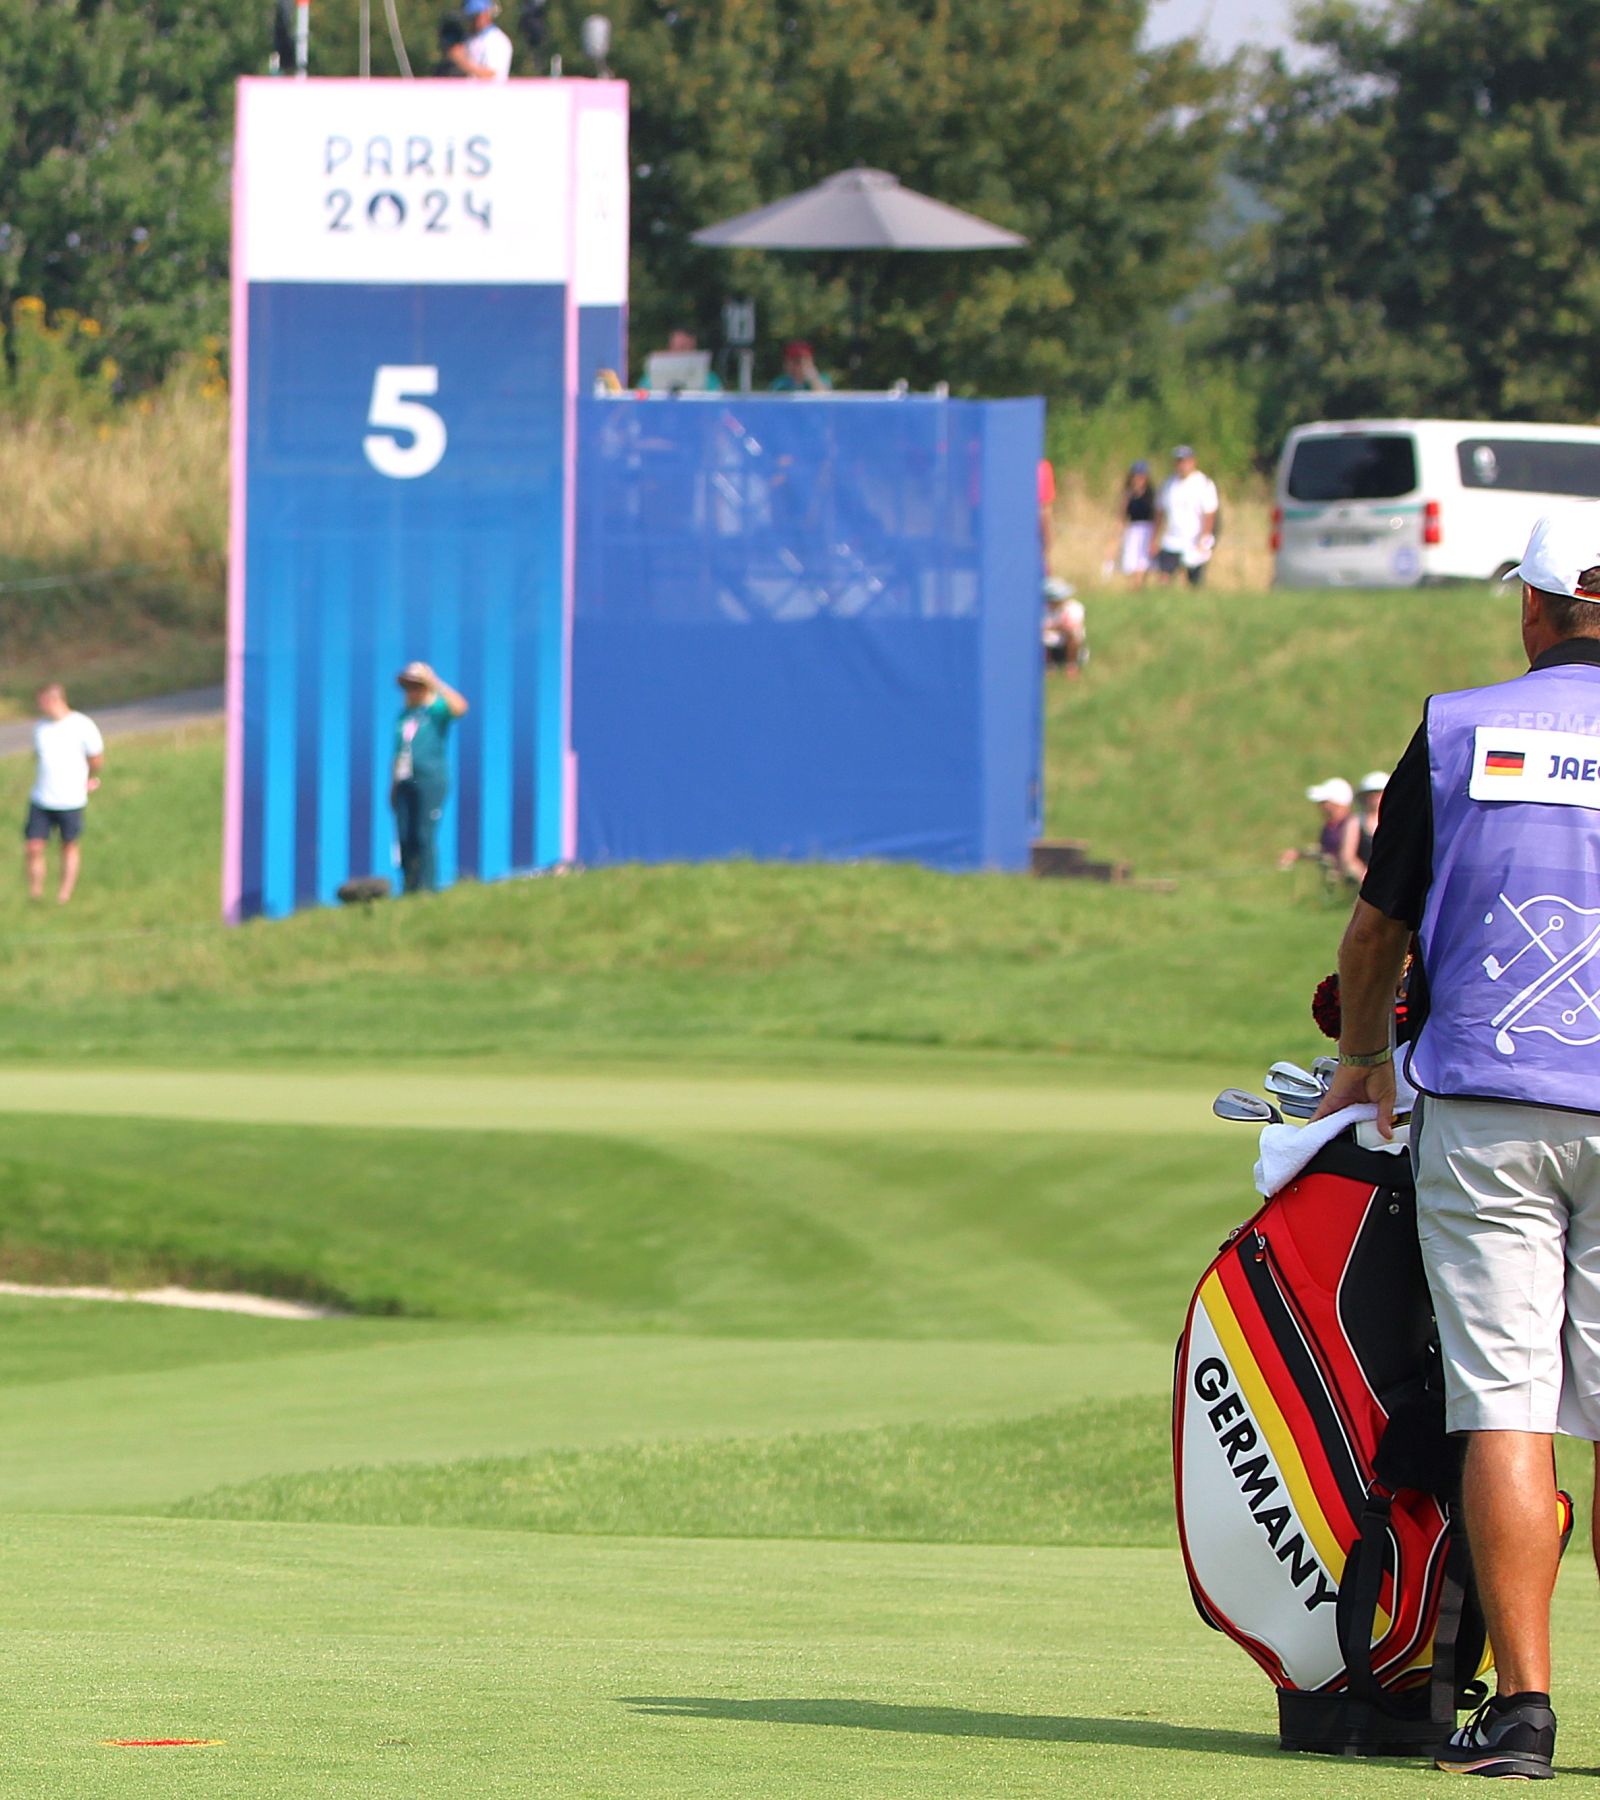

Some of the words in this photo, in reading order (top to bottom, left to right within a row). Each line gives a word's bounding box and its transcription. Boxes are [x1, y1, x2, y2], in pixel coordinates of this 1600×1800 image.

[326, 189, 491, 232] 2024
[364, 365, 448, 480] 5
[1547, 755, 1600, 782] JAE
[1194, 1357, 1338, 1612] GERMANY
